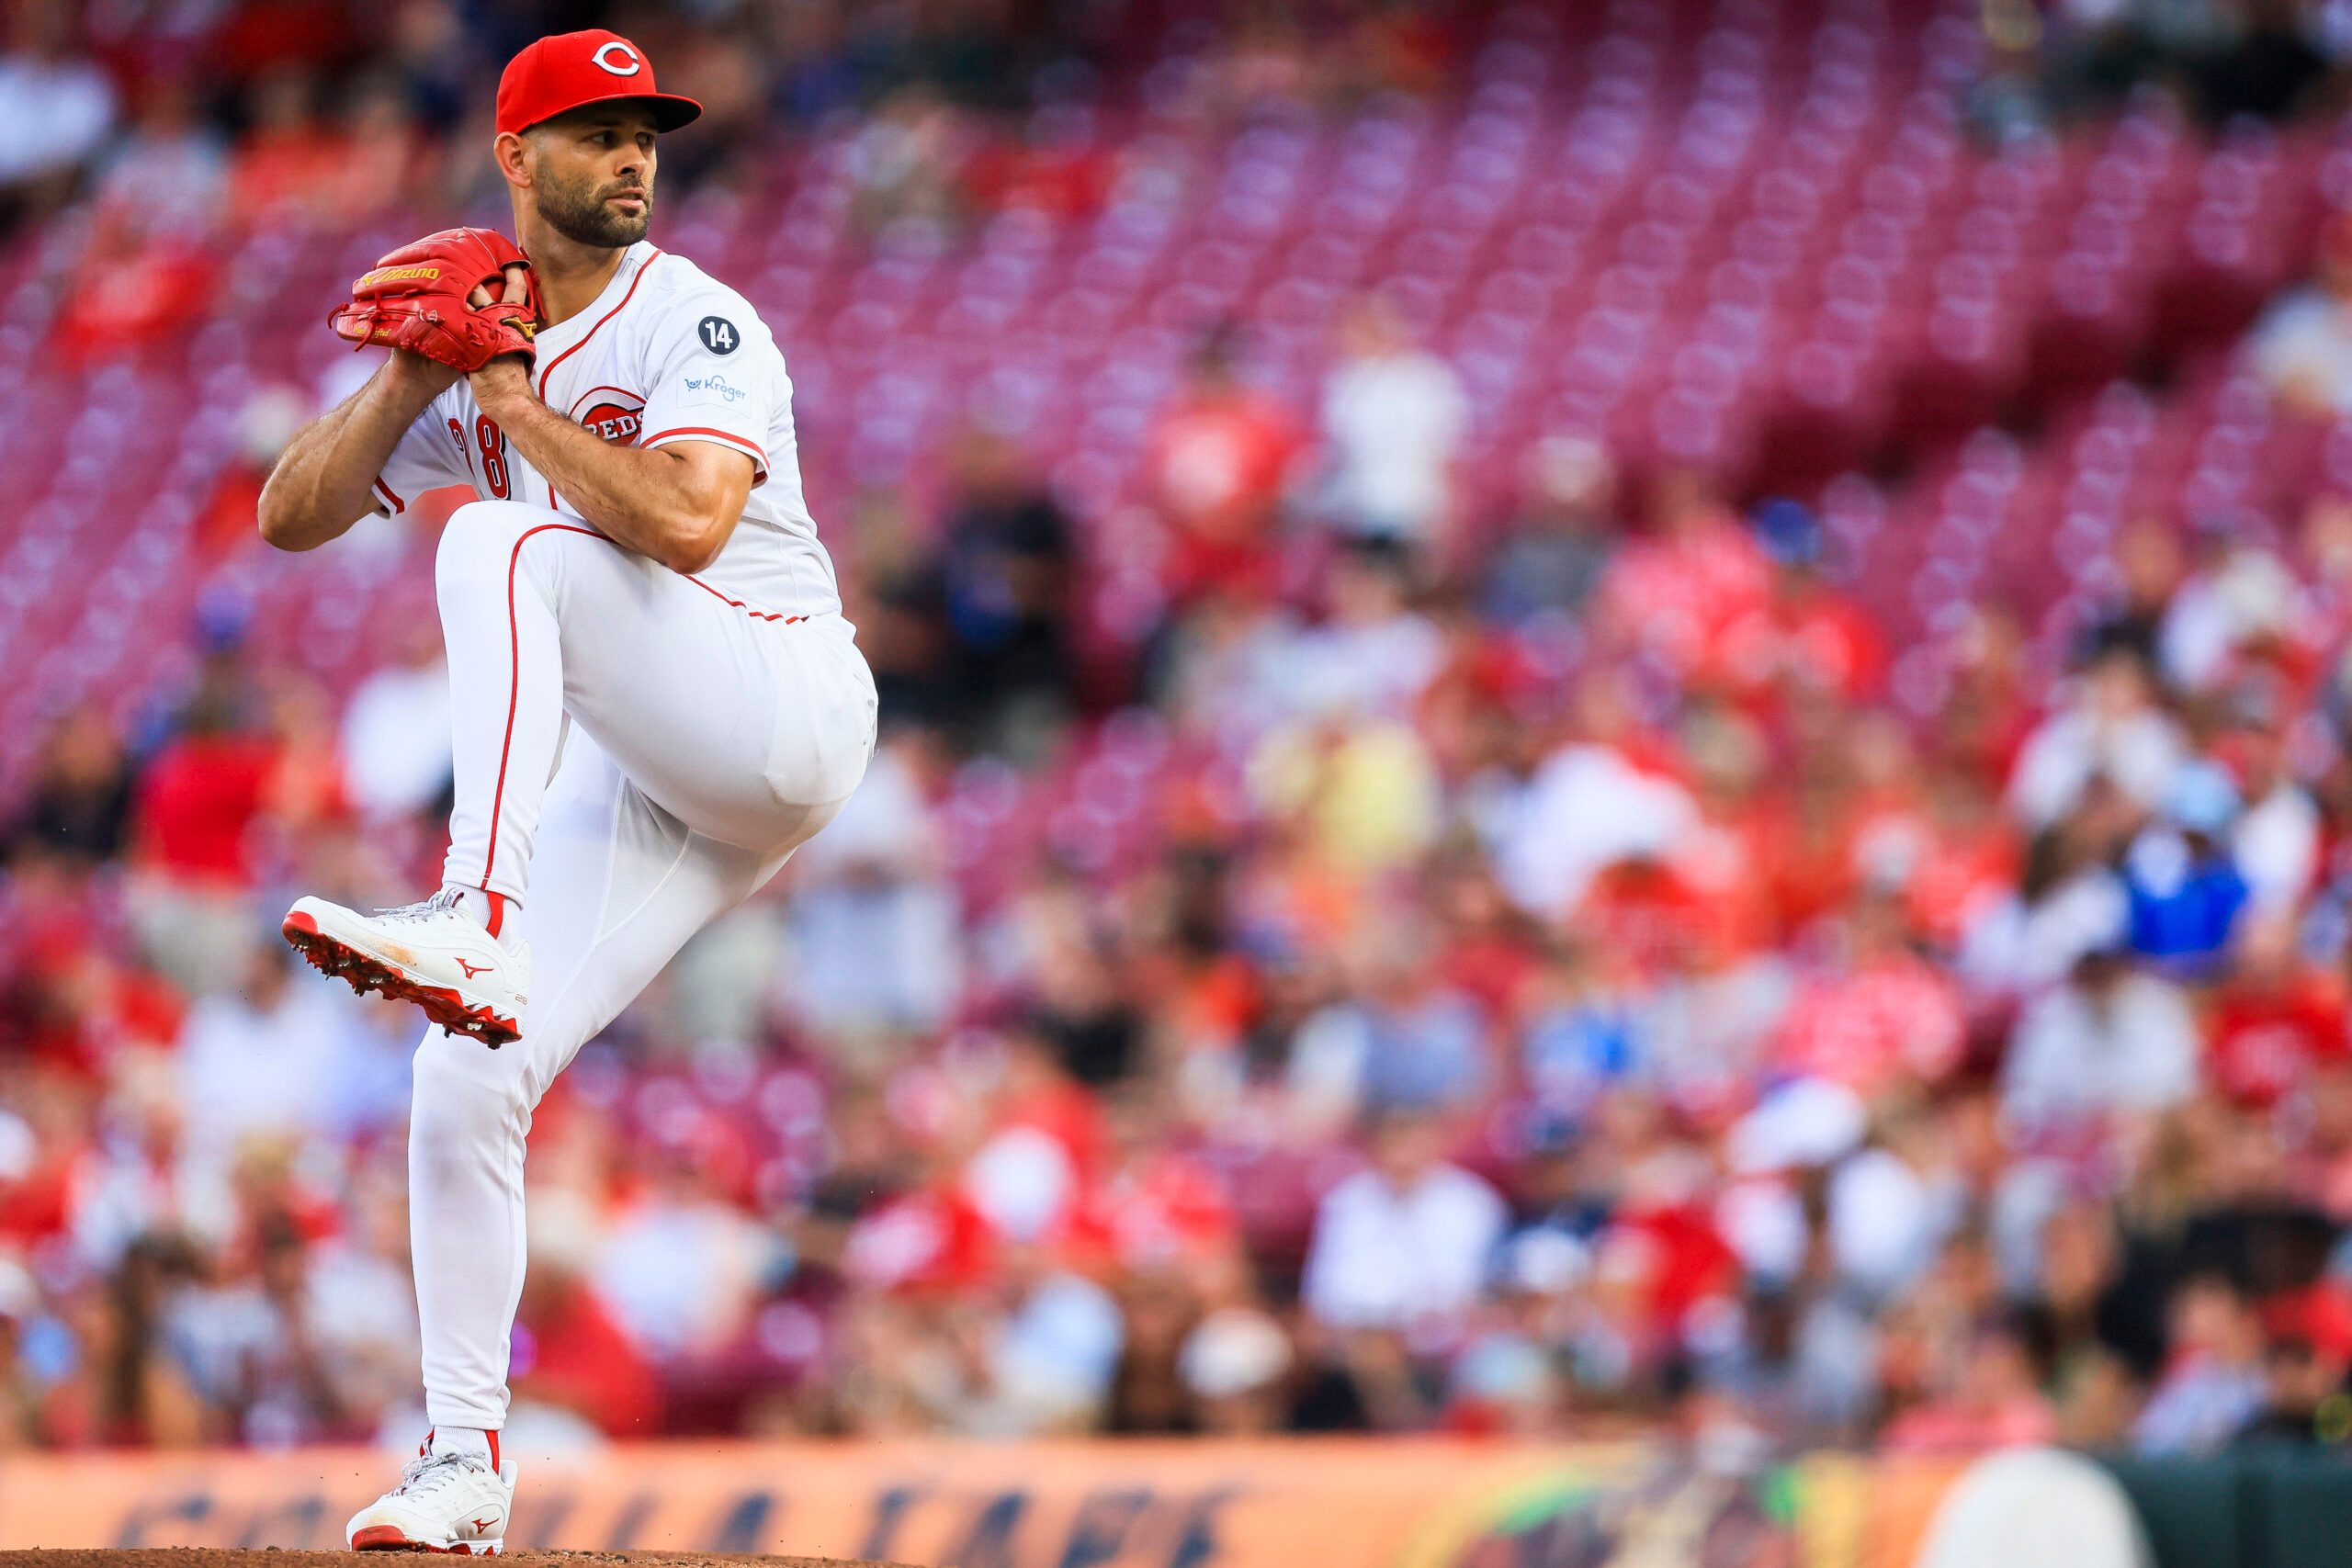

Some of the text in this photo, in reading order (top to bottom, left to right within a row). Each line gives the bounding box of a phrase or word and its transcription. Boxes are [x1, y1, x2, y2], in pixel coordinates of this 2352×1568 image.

[592, 41, 640, 77] C
[705, 321, 733, 349] 14
[705, 375, 746, 401] Kroger
